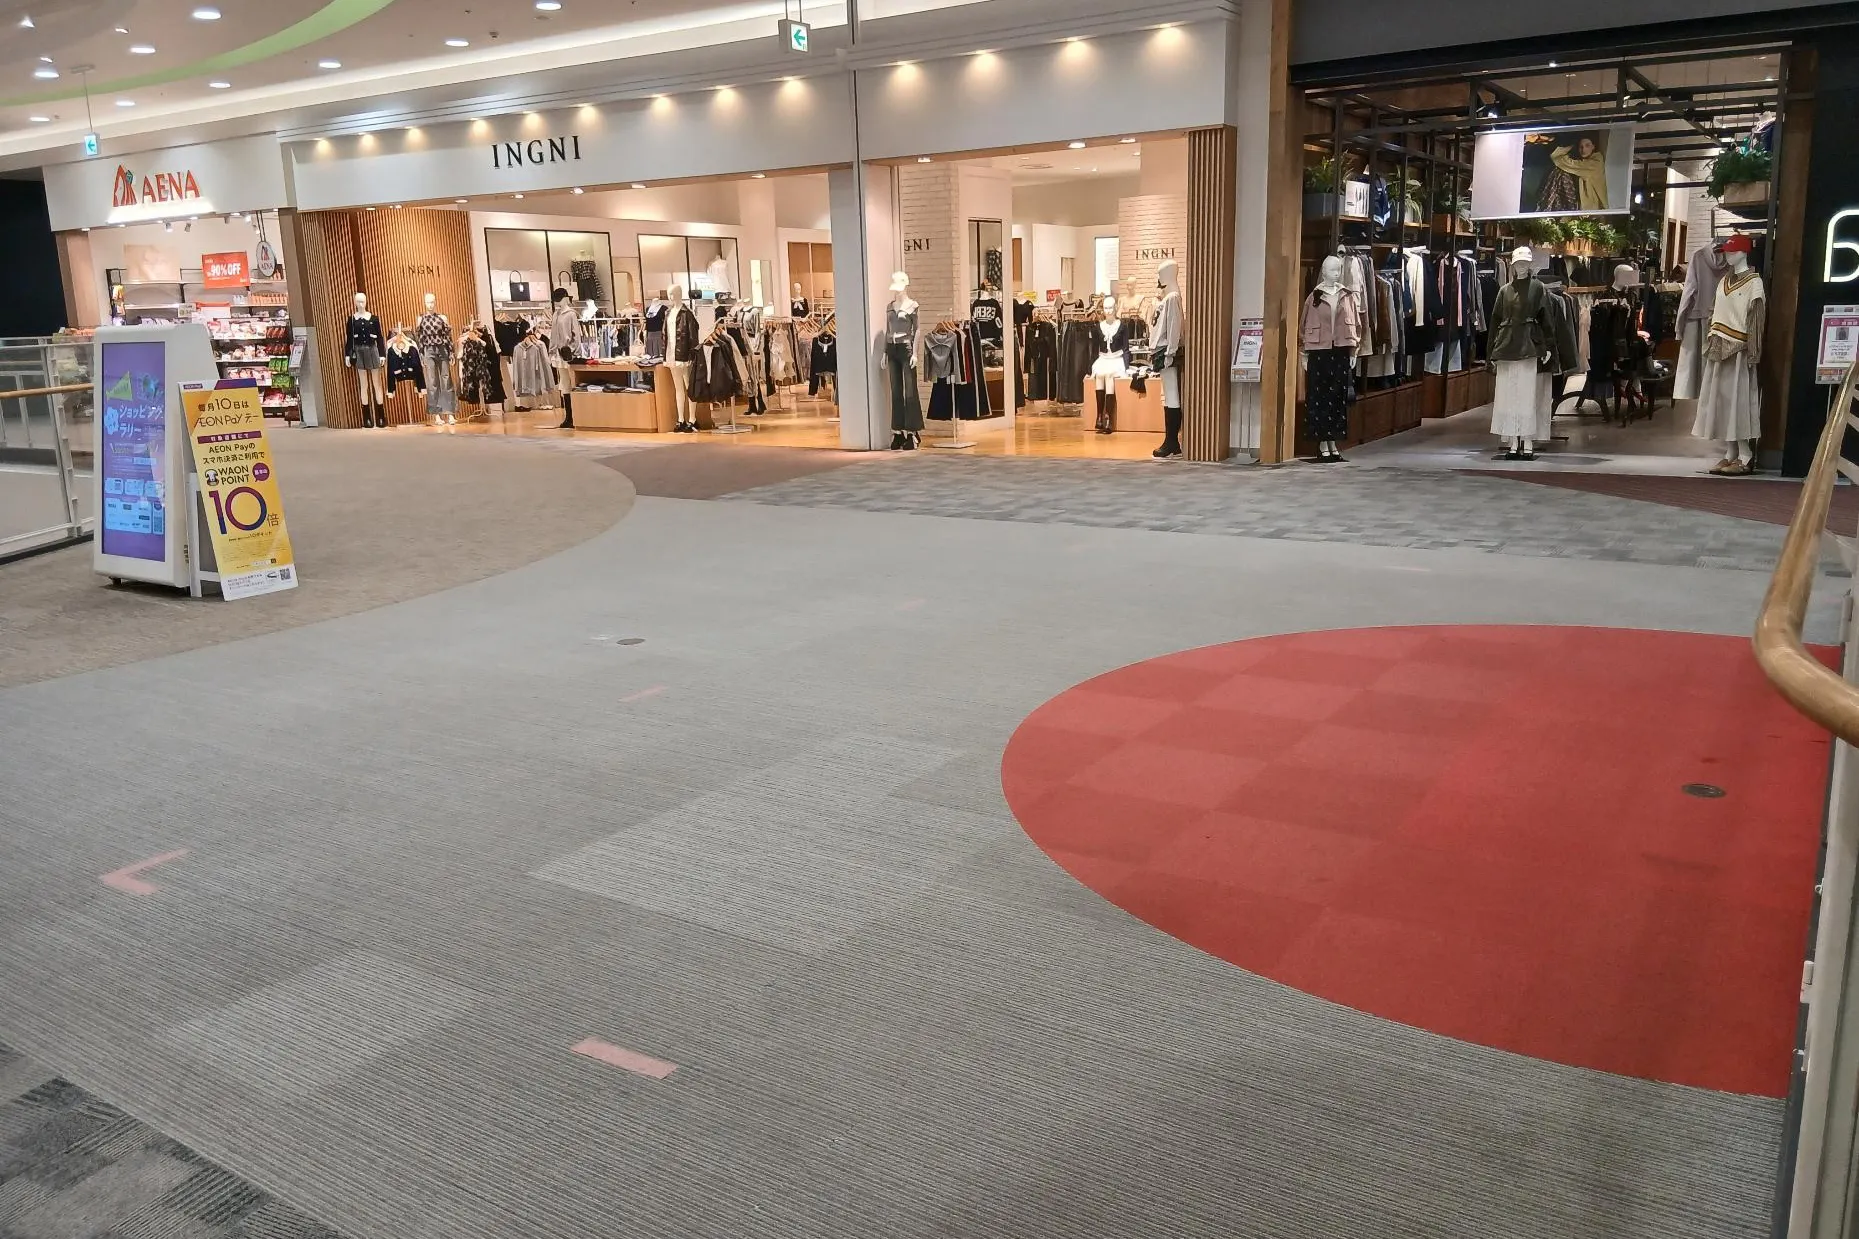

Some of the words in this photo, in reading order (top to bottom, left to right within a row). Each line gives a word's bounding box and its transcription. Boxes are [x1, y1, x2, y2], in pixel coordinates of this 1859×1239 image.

[491, 135, 581, 168] INGNI
[142, 169, 200, 204] AENA
[1136, 247, 1174, 260] INGNI
[119, 403, 164, 420] ショッピング
[198, 398, 249, 412] 毎月10日は
[119, 422, 142, 438] ラリー
[209, 444, 232, 454] AEON
[234, 442, 256, 452] Payの
[218, 464, 249, 476] WAON
[221, 473, 250, 486] POINT
